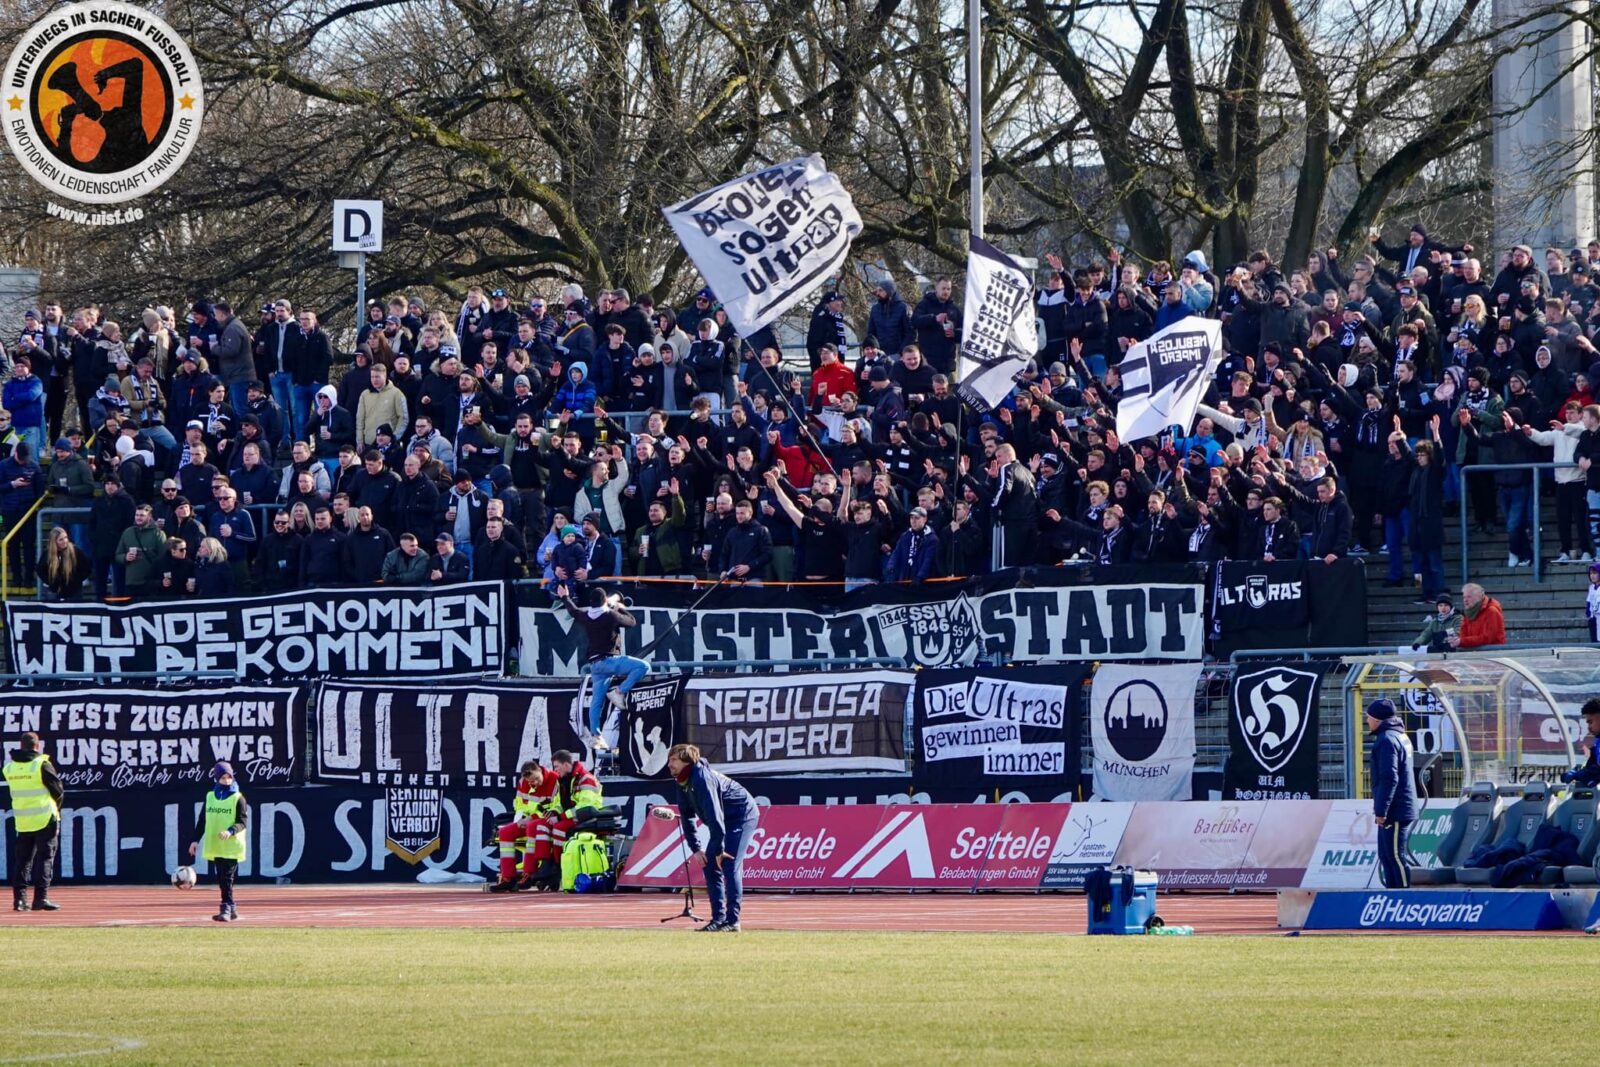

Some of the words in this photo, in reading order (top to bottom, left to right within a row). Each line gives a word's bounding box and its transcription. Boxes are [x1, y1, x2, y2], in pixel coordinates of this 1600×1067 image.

[344, 208, 371, 242] D
[14, 610, 229, 646] FREUNDE
[241, 592, 498, 640] GENOMMEN
[909, 603, 948, 621] SSV
[910, 618, 950, 635] 1846
[980, 588, 1197, 657] STADT
[17, 643, 134, 682] WUT
[156, 626, 499, 681] BEKOMMEN!
[50, 702, 121, 731] FEST
[130, 701, 275, 732] ZUSAMMEN
[636, 697, 666, 712] IMPERO
[700, 682, 885, 725] NEBULOSA
[926, 687, 966, 716] Die
[971, 680, 1063, 725] Ultras
[56, 738, 200, 766] UNSEREN
[210, 735, 274, 761] WEG
[725, 723, 854, 761] IMPERO
[924, 724, 1018, 759] gewinnen
[111, 762, 172, 789] Brüder
[178, 766, 204, 782] vor
[245, 757, 295, 783] Toren!
[987, 747, 1062, 772] immer
[362, 772, 449, 786] BROKEN
[390, 801, 439, 817] STADION
[391, 816, 438, 833] VERBOT
[1194, 818, 1255, 834] Barfüßer
[743, 827, 837, 860] Settele
[949, 826, 1051, 860] Settele
[742, 866, 794, 882] dachungen
[795, 866, 826, 879] GmbH
[939, 866, 1007, 882] Bedachungen
[1008, 866, 1041, 879] GmbH
[1380, 899, 1484, 926] Husqvarna
